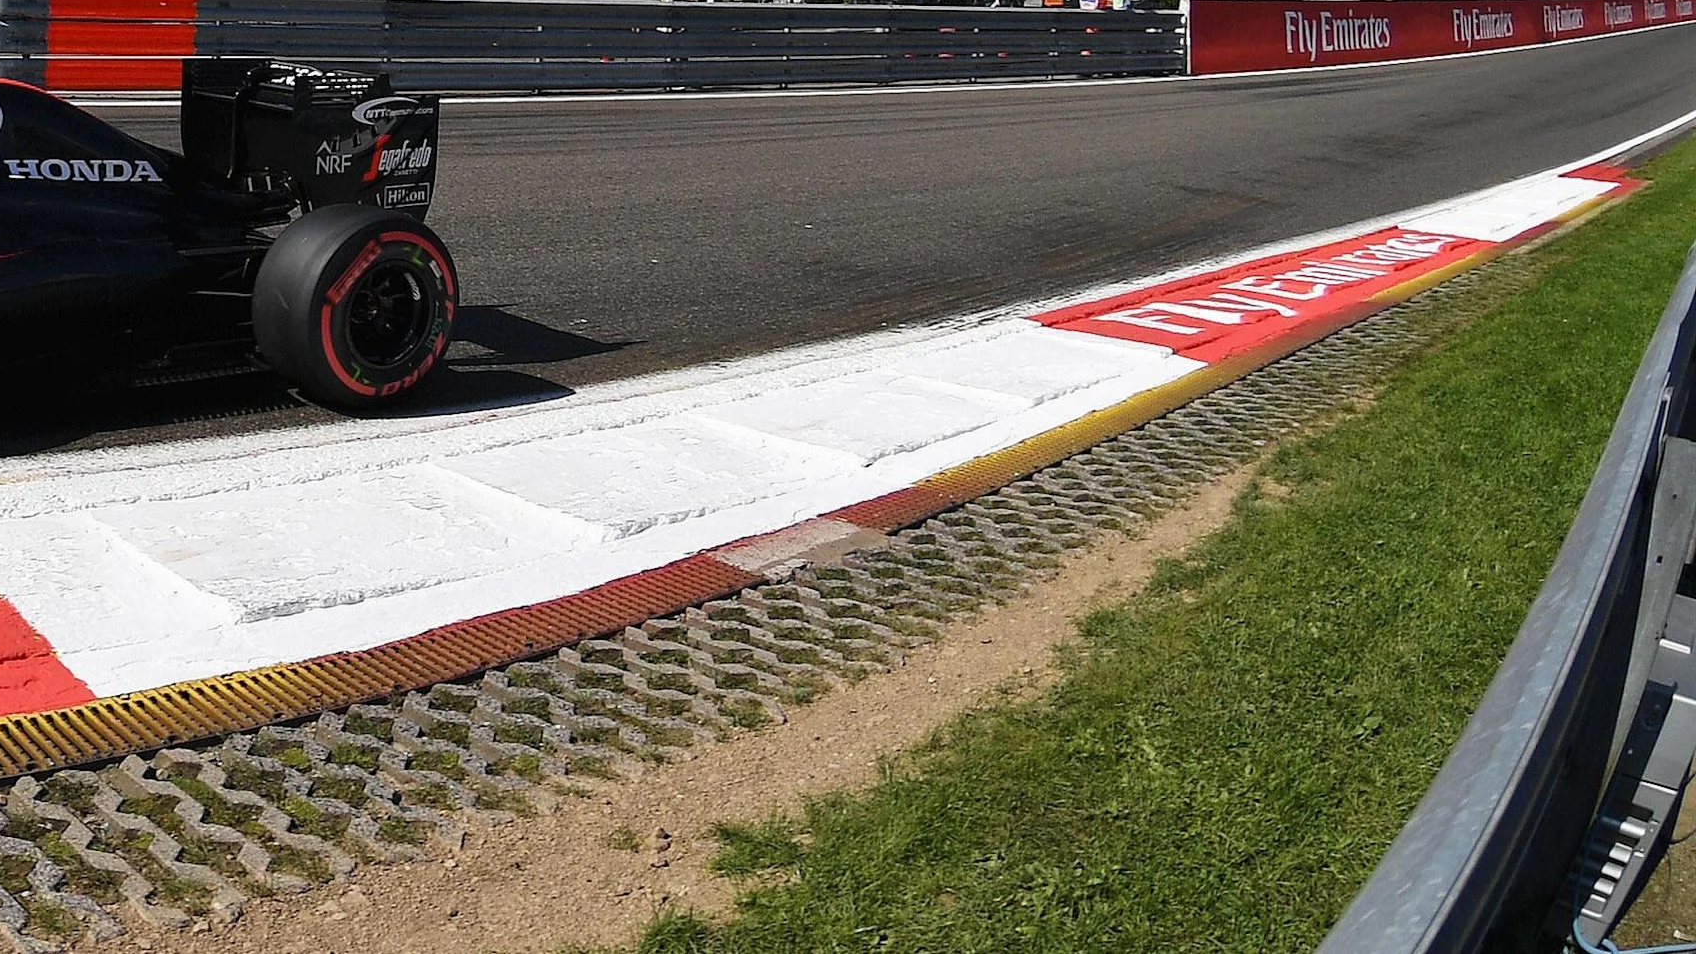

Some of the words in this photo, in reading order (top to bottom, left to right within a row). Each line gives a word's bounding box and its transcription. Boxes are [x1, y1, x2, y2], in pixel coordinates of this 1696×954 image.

[1285, 10, 1318, 62] Fly
[1320, 9, 1391, 52] Emirates
[1453, 9, 1472, 48] Fly
[1473, 7, 1514, 41] Emirates
[4, 159, 163, 182] HONDA
[315, 154, 353, 175] NRF
[363, 134, 432, 182] Segafredo
[388, 190, 425, 204] Hilton
[1091, 292, 1299, 335] Fly
